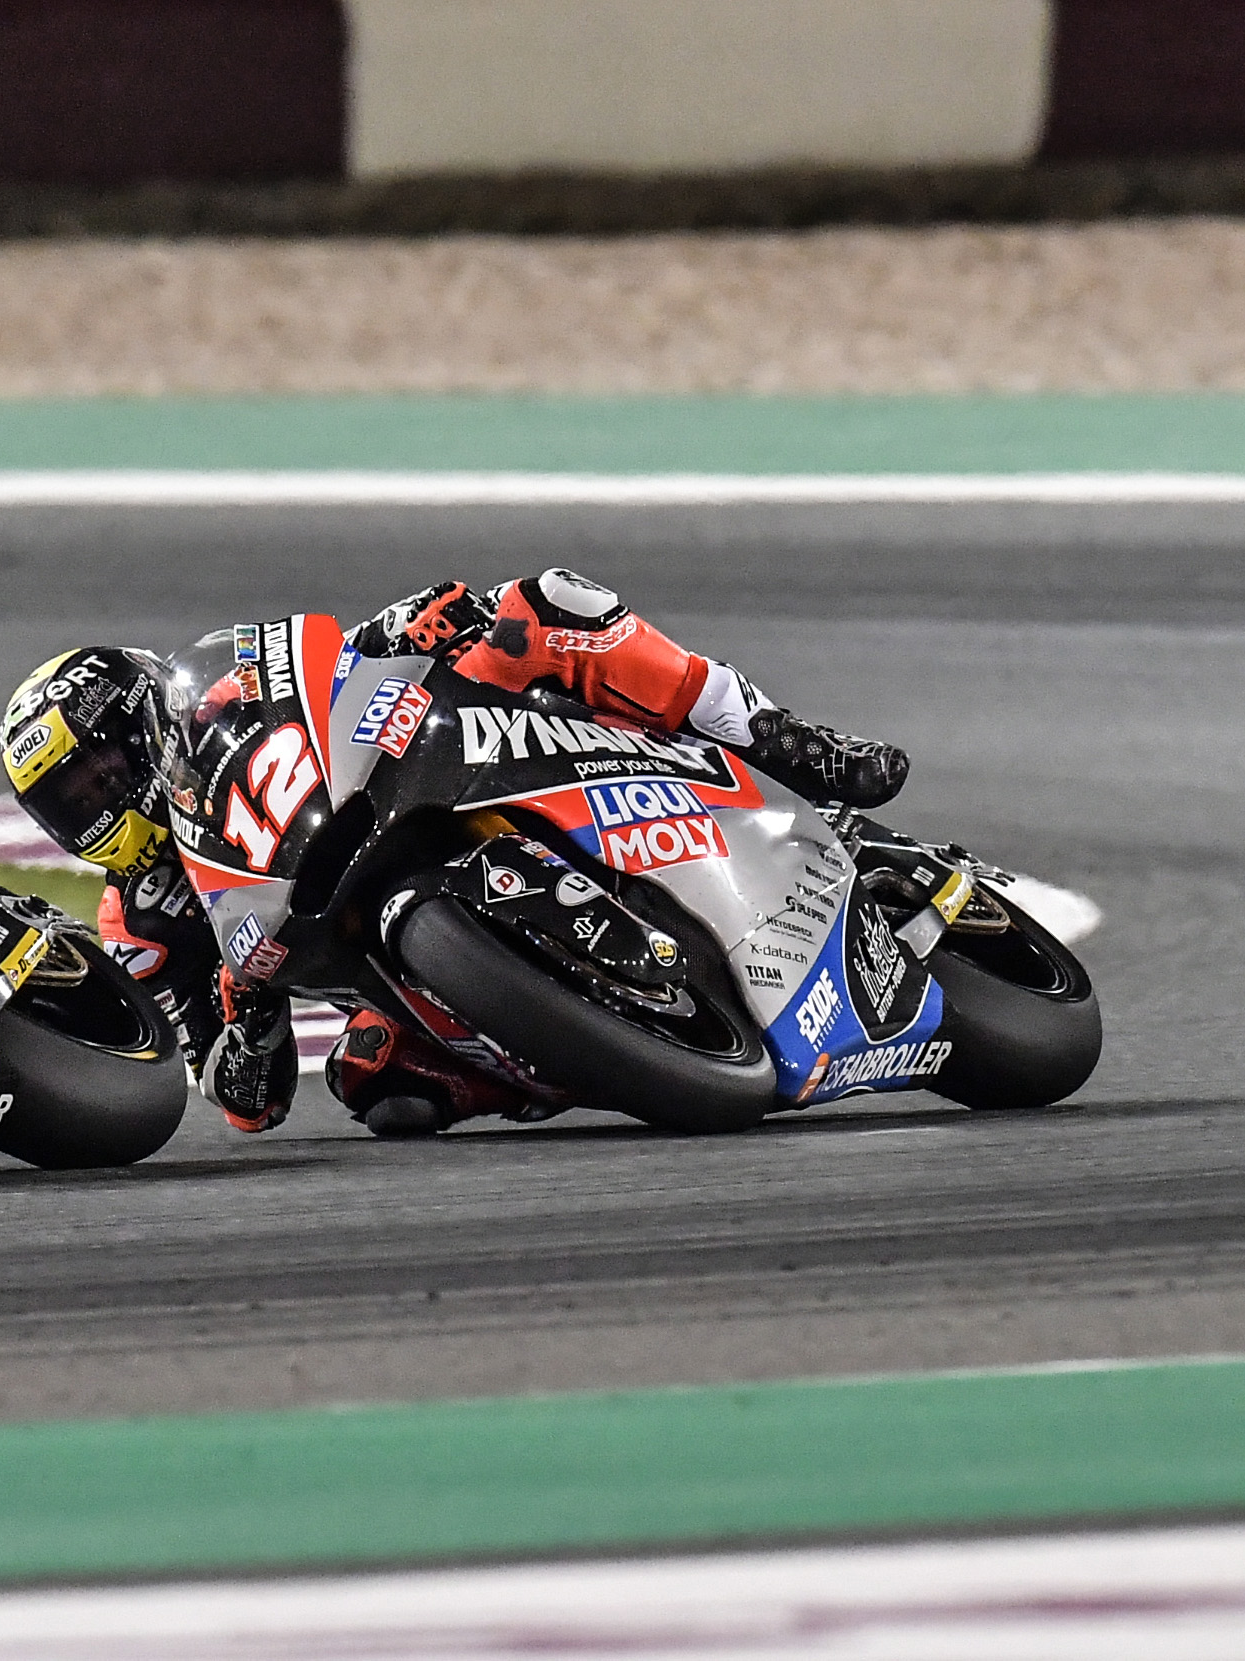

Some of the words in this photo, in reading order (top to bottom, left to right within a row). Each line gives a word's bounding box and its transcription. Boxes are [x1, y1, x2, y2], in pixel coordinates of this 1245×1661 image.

[264, 621, 294, 703] DYNAVOLT
[121, 673, 149, 715] LATTESSO
[354, 679, 407, 743] LIQUI
[380, 684, 429, 753] MOLY
[12, 729, 45, 764] SHOEI
[456, 706, 721, 776] DYNAVOLT
[573, 757, 620, 780] power
[621, 758, 653, 777] your
[222, 722, 323, 873] 12
[593, 780, 703, 828] LIQUI
[74, 810, 114, 848] LATTESSO
[605, 818, 722, 873] MOLY
[140, 875, 160, 897] LP
[227, 913, 264, 967] LIQUI
[244, 938, 282, 978] MOLY
[745, 964, 784, 982] TITAN
[795, 967, 843, 1045] EXIDE
